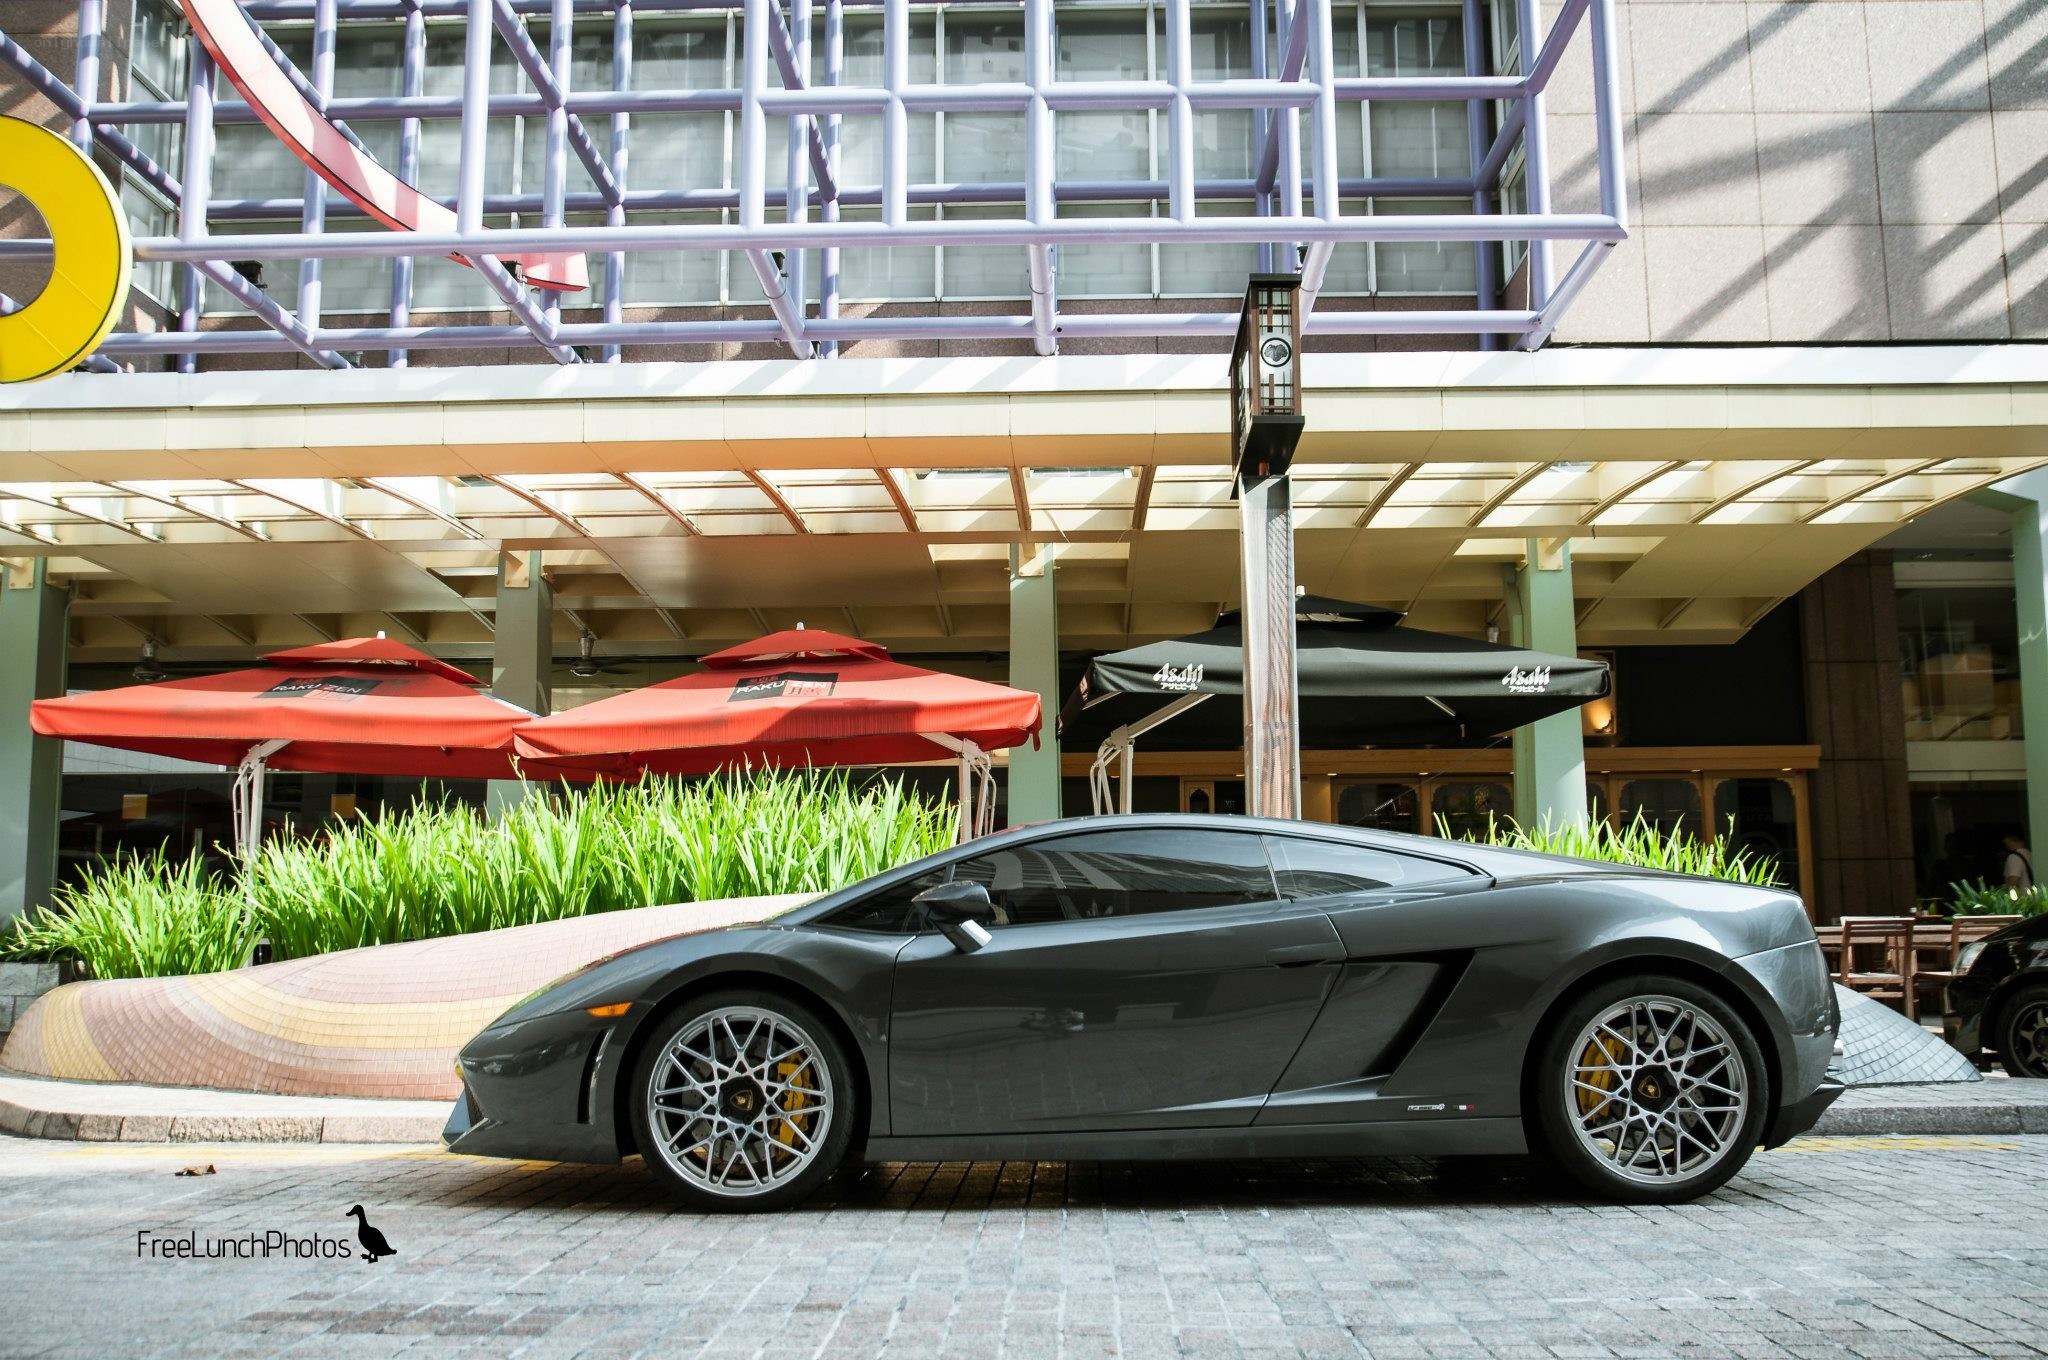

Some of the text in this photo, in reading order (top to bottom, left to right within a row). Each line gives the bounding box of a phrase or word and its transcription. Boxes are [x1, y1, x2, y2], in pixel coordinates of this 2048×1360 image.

[1152, 662, 1204, 682] Asahi
[1501, 665, 1551, 685] Asahi
[272, 683, 361, 694] RAKU ZEN
[736, 680, 786, 694] RAKU
[790, 680, 827, 688] ZEN
[1508, 685, 1546, 693] アサヒビール
